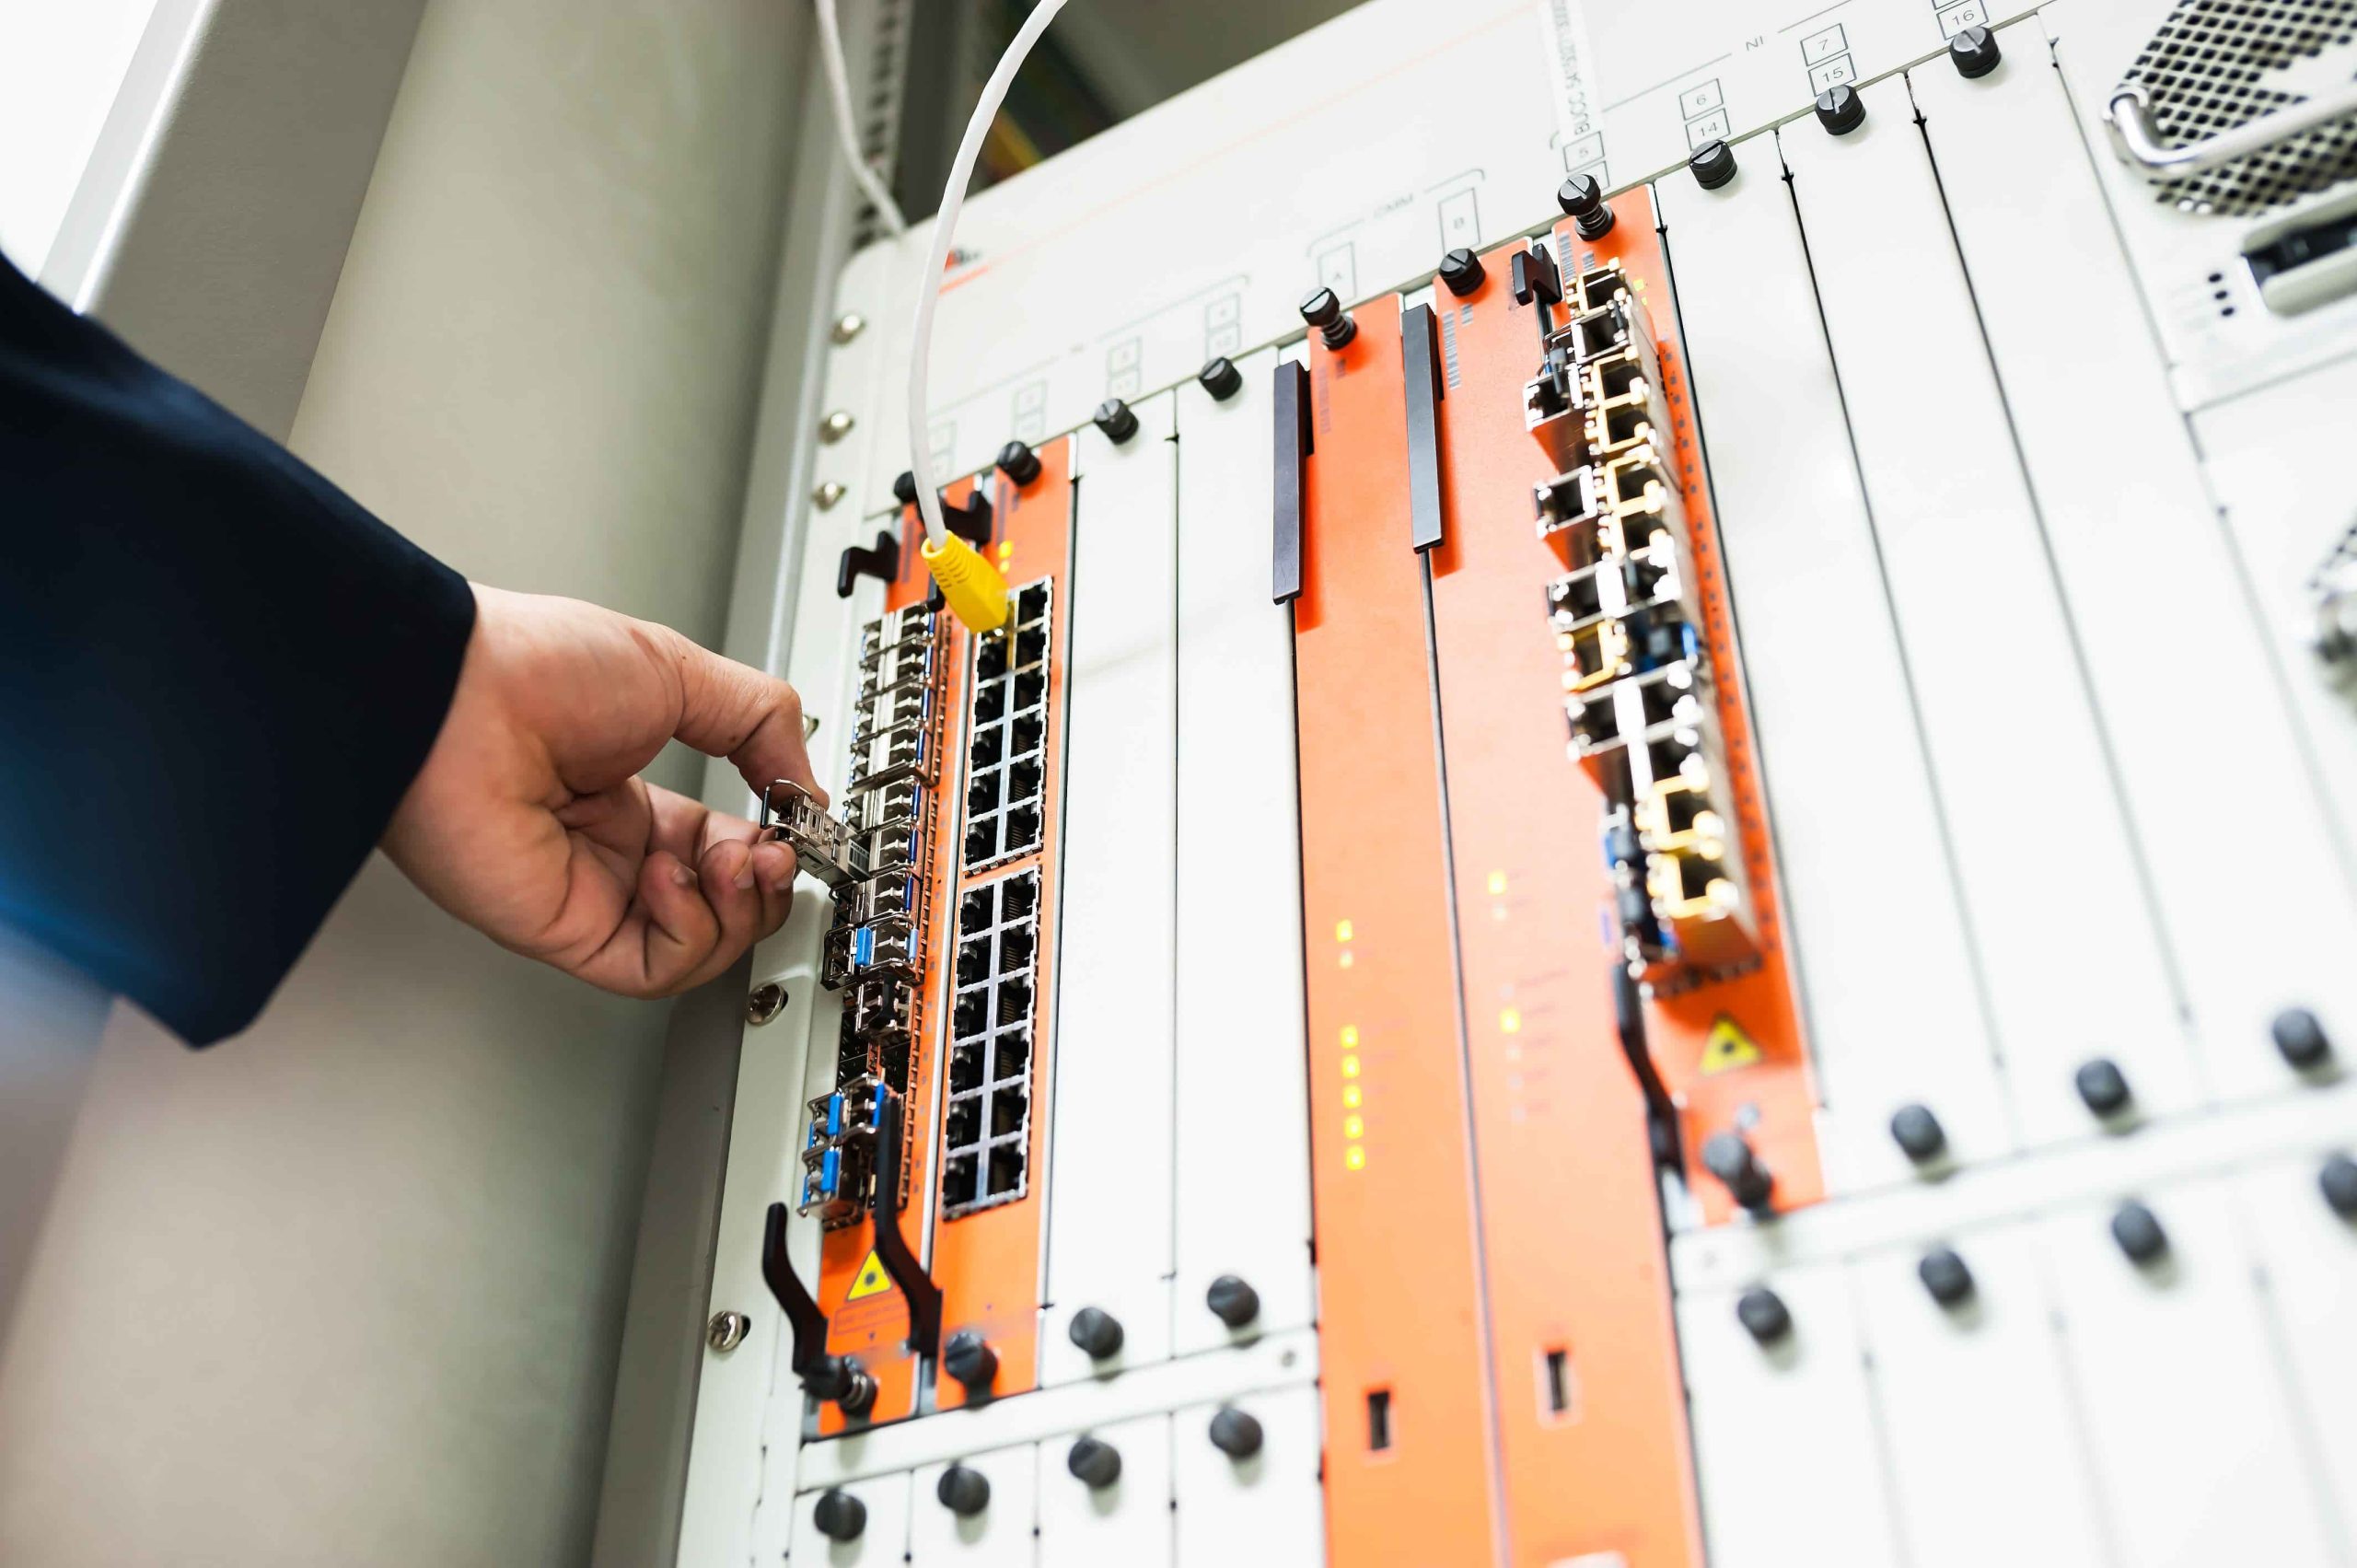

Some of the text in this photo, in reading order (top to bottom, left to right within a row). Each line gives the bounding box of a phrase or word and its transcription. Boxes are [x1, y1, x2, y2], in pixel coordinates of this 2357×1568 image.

[1952, 9, 1975, 26] 16
[1745, 35, 1763, 52] NI
[1817, 39, 1829, 52] 7
[1822, 66, 1844, 83] 15
[1696, 94, 1707, 106] 6
[1700, 122, 1717, 137] 14
